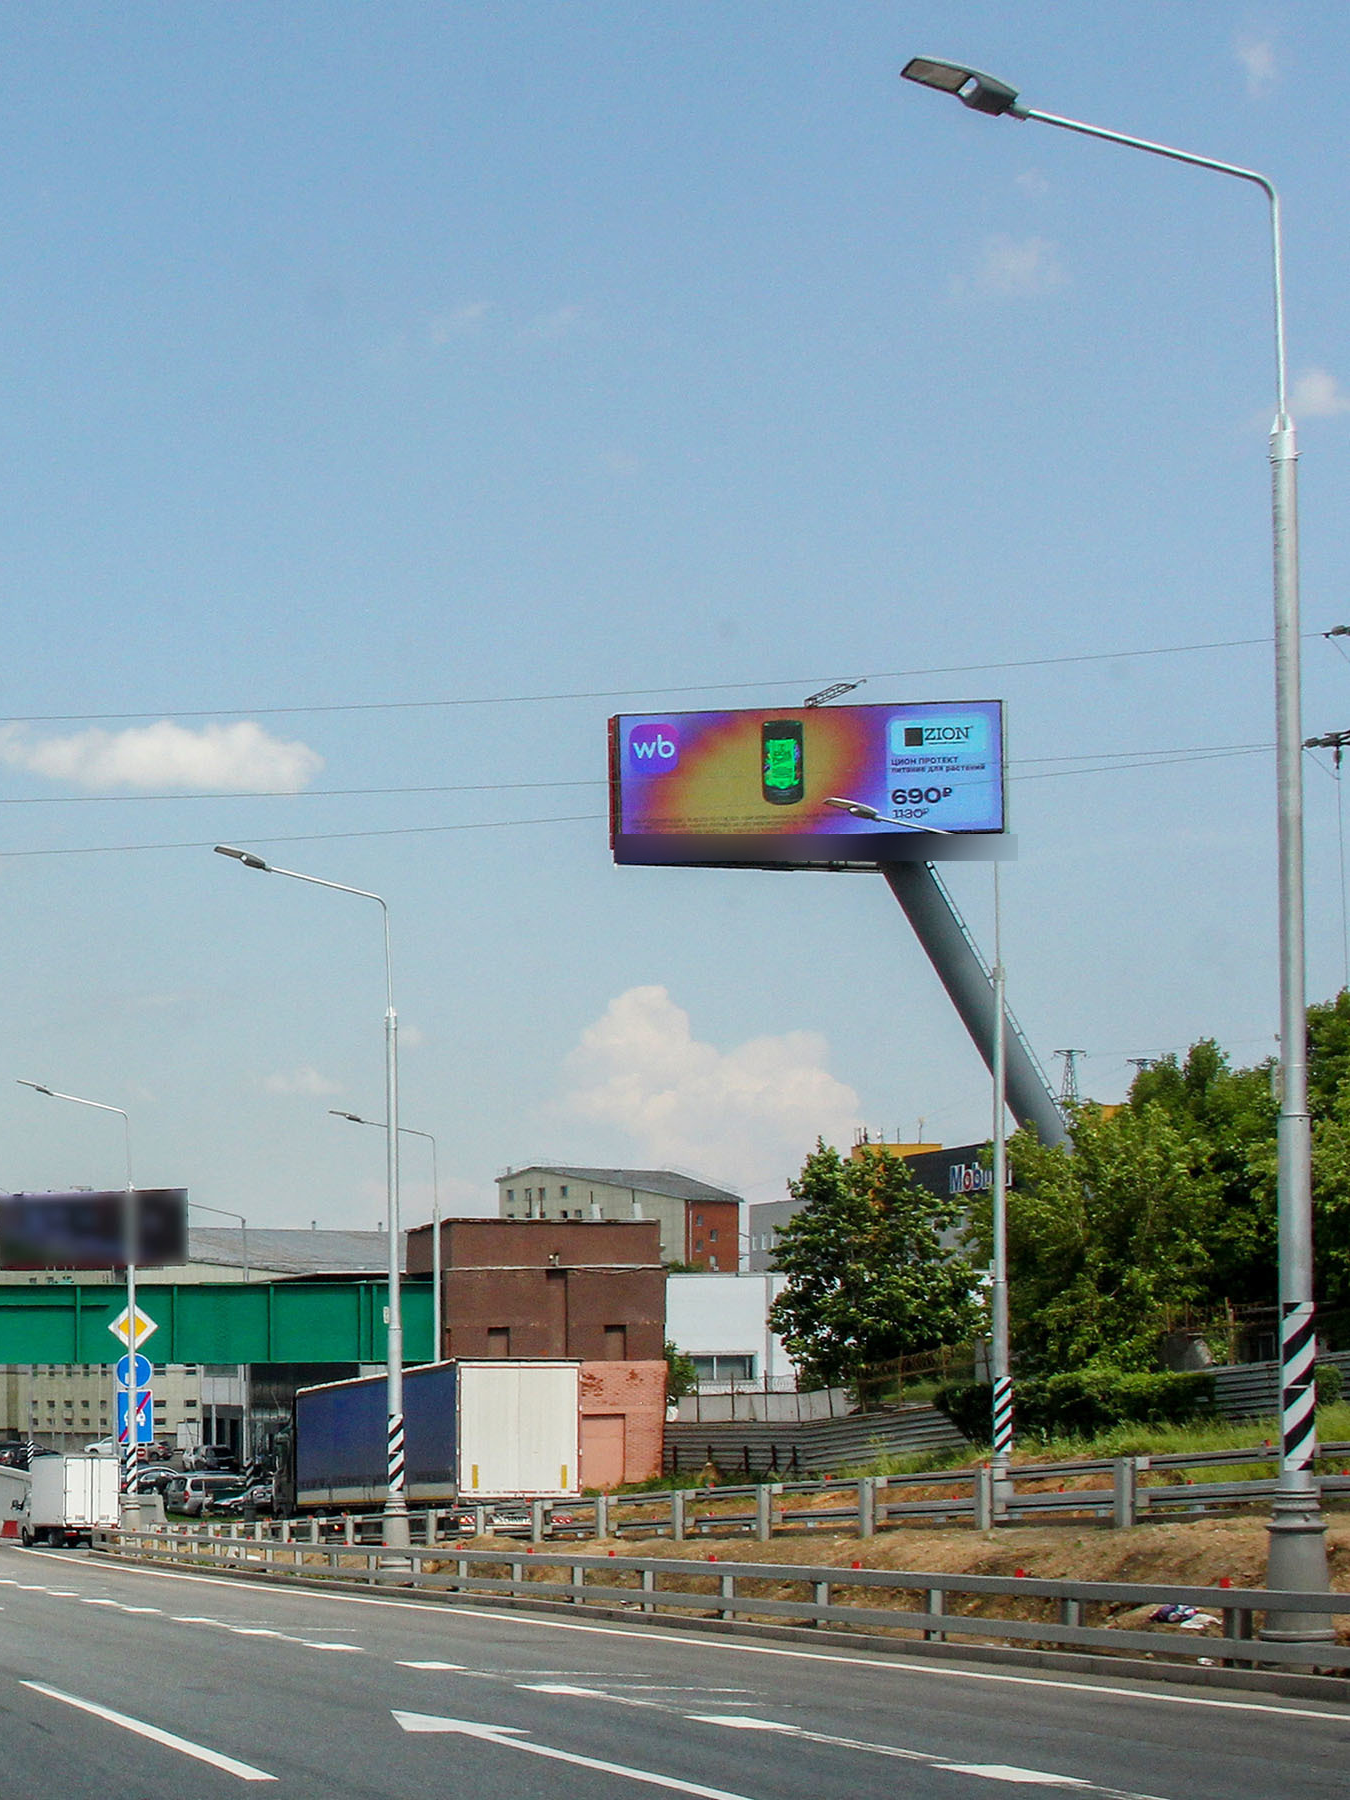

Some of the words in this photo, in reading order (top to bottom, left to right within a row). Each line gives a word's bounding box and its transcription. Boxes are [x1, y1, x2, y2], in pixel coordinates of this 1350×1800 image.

[924, 727, 970, 741] ZION
[632, 734, 675, 759] wb
[891, 758, 917, 767] ЦИОН
[919, 756, 958, 765] ПРОТЕКТ
[927, 766, 943, 774] для
